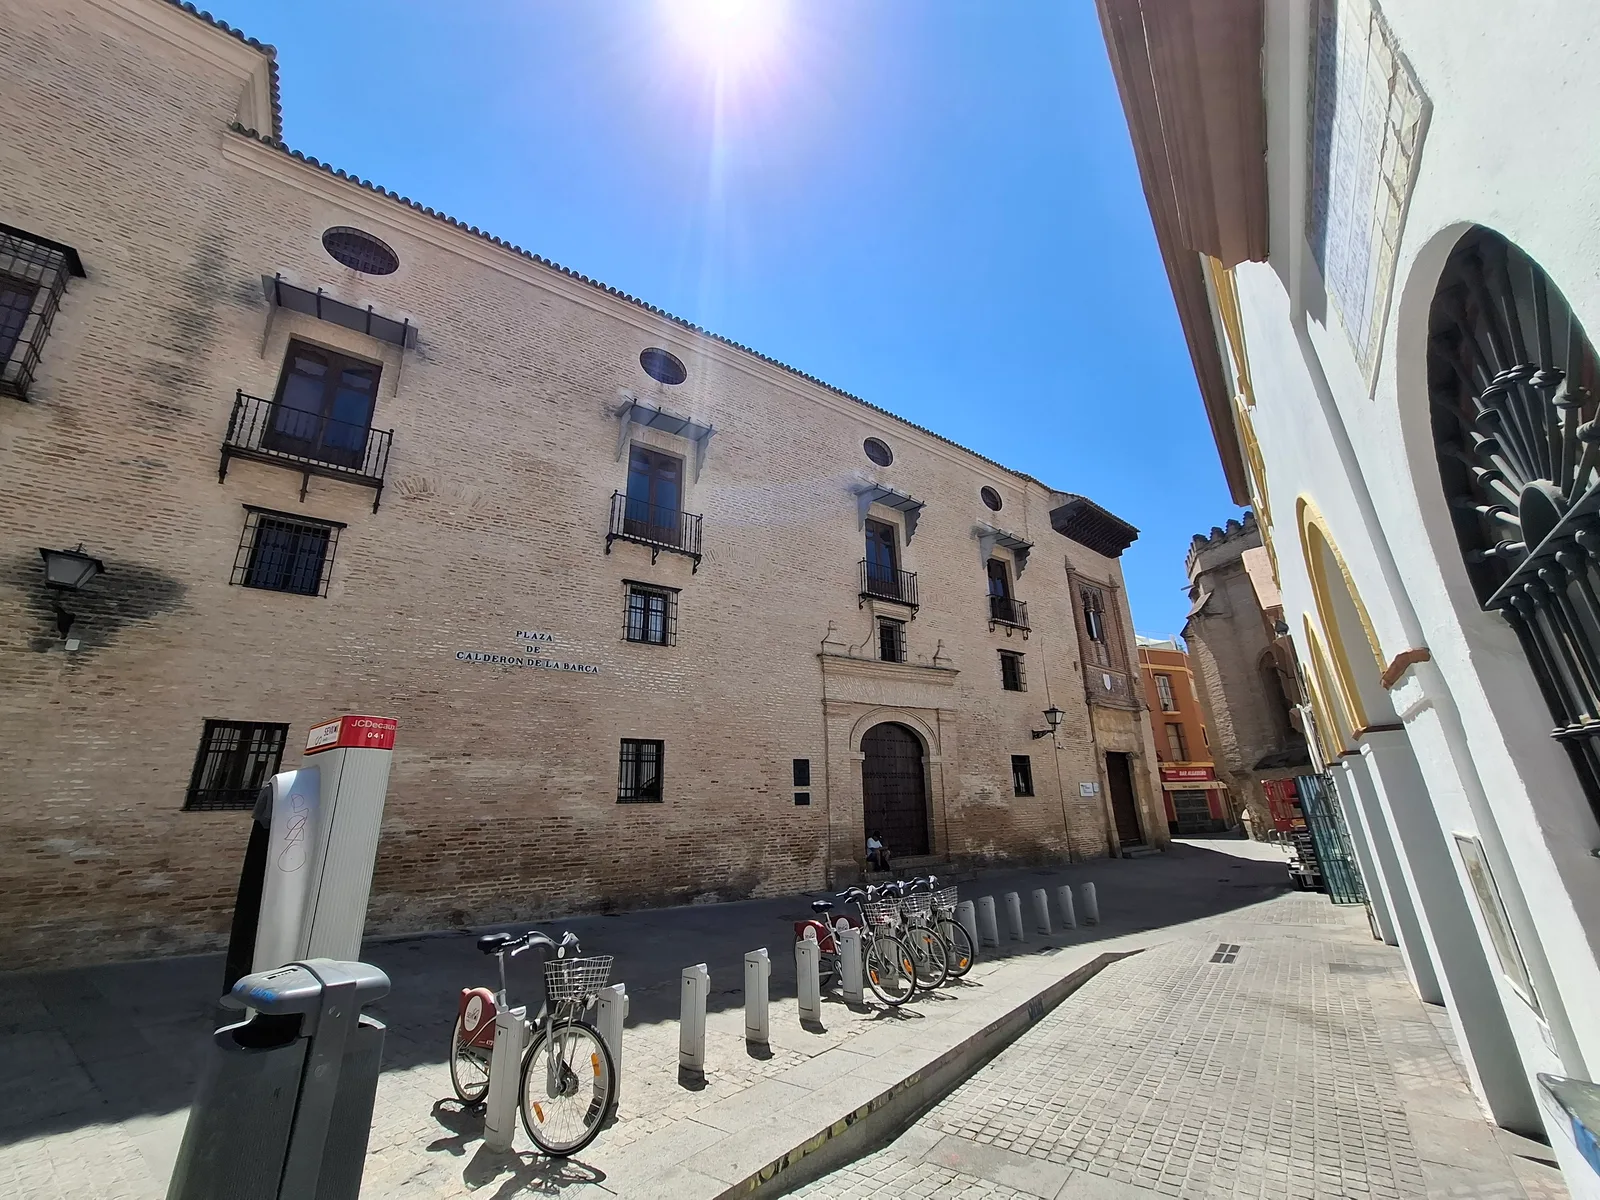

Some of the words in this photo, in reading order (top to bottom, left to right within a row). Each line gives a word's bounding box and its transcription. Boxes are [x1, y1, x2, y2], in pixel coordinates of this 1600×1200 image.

[516, 630, 553, 642] PLAZA
[526, 645, 541, 654] DE
[456, 651, 524, 665] CALDERON
[527, 658, 542, 667] DE
[545, 660, 560, 669] LA
[563, 663, 599, 673] BARCA
[351, 719, 396, 731] JCDecaux
[367, 731, 384, 740] 041
